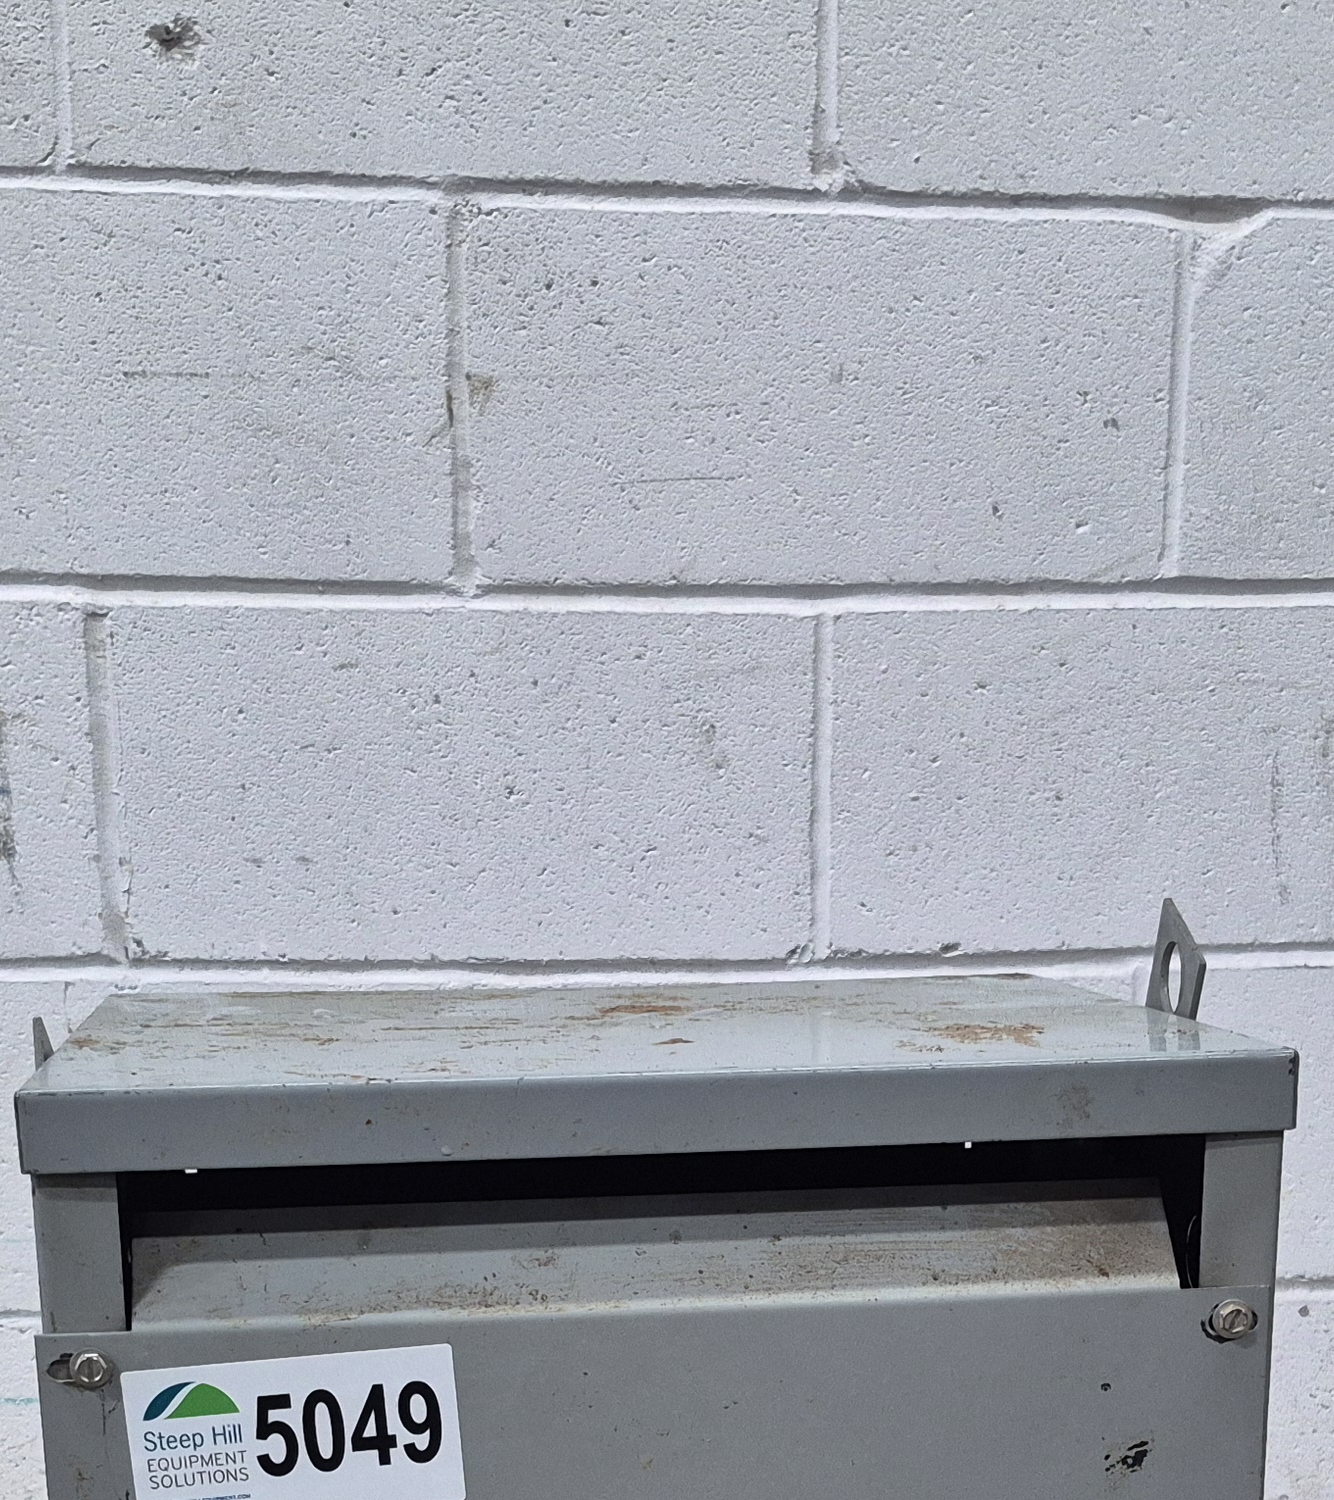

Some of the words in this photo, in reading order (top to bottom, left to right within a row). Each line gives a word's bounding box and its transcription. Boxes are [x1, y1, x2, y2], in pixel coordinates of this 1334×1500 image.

[143, 1429, 205, 1453] Steep
[212, 1423, 243, 1446] Hill
[255, 1379, 443, 1477] 5049
[147, 1450, 248, 1473] EQUIPMENT
[148, 1467, 249, 1490] SOLUTIONS
